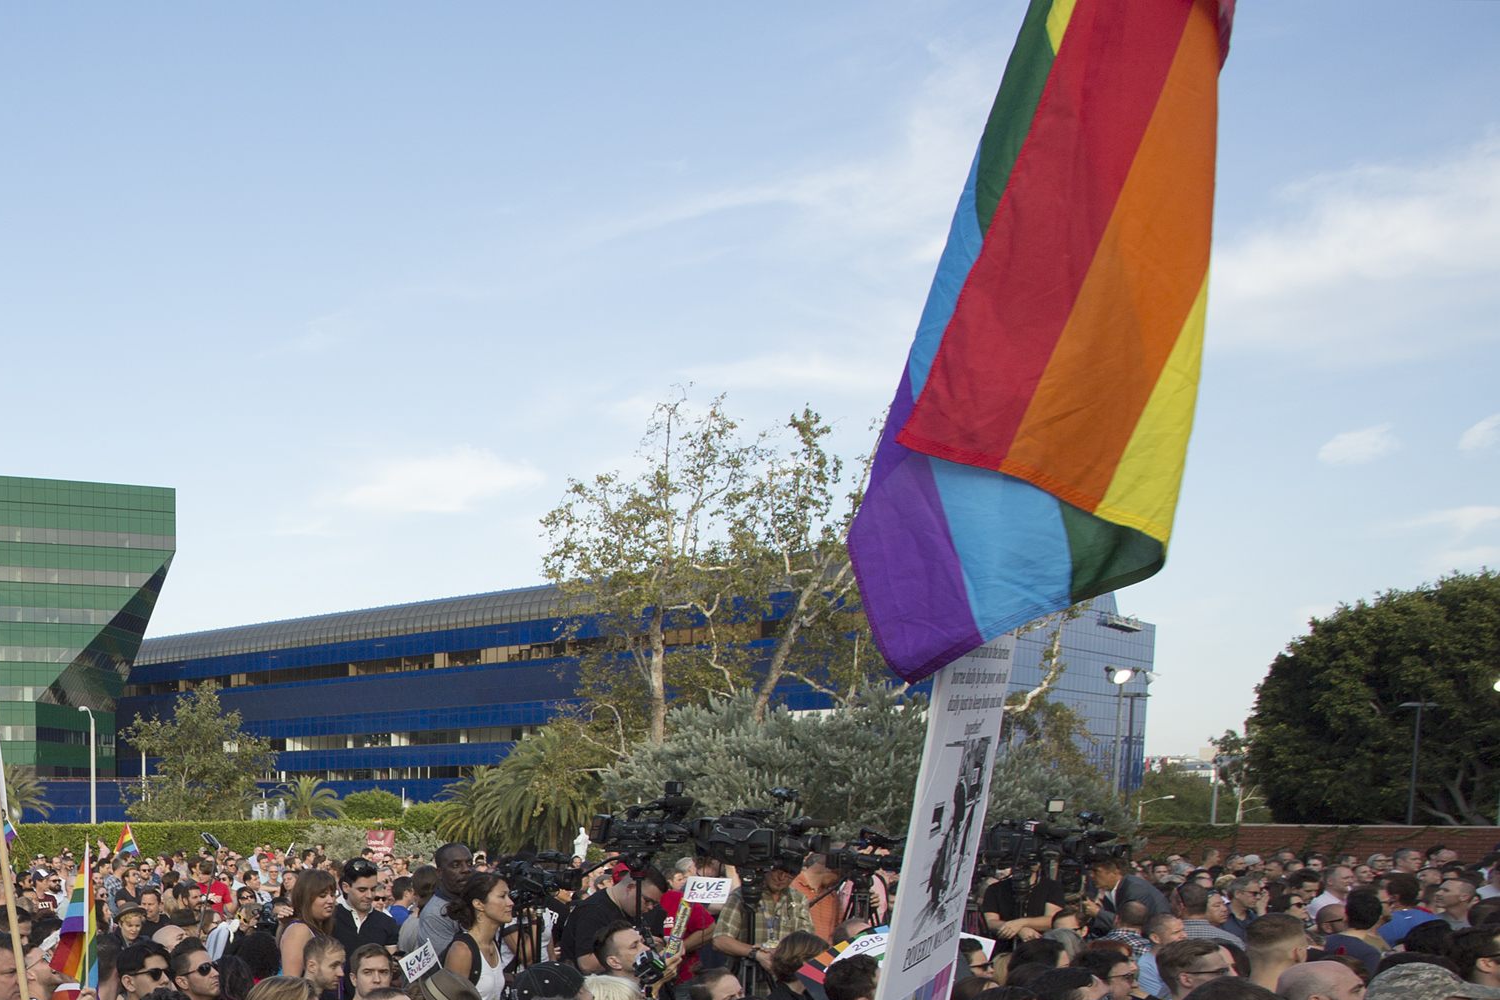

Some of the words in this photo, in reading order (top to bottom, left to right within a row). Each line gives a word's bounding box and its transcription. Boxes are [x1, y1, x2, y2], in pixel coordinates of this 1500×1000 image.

[687, 891, 722, 901] RULES
[690, 881, 726, 892] LOVE
[851, 935, 884, 952] 2015
[902, 934, 936, 969] POVERTY
[405, 945, 430, 971] LOVE
[407, 954, 432, 979] RULES
